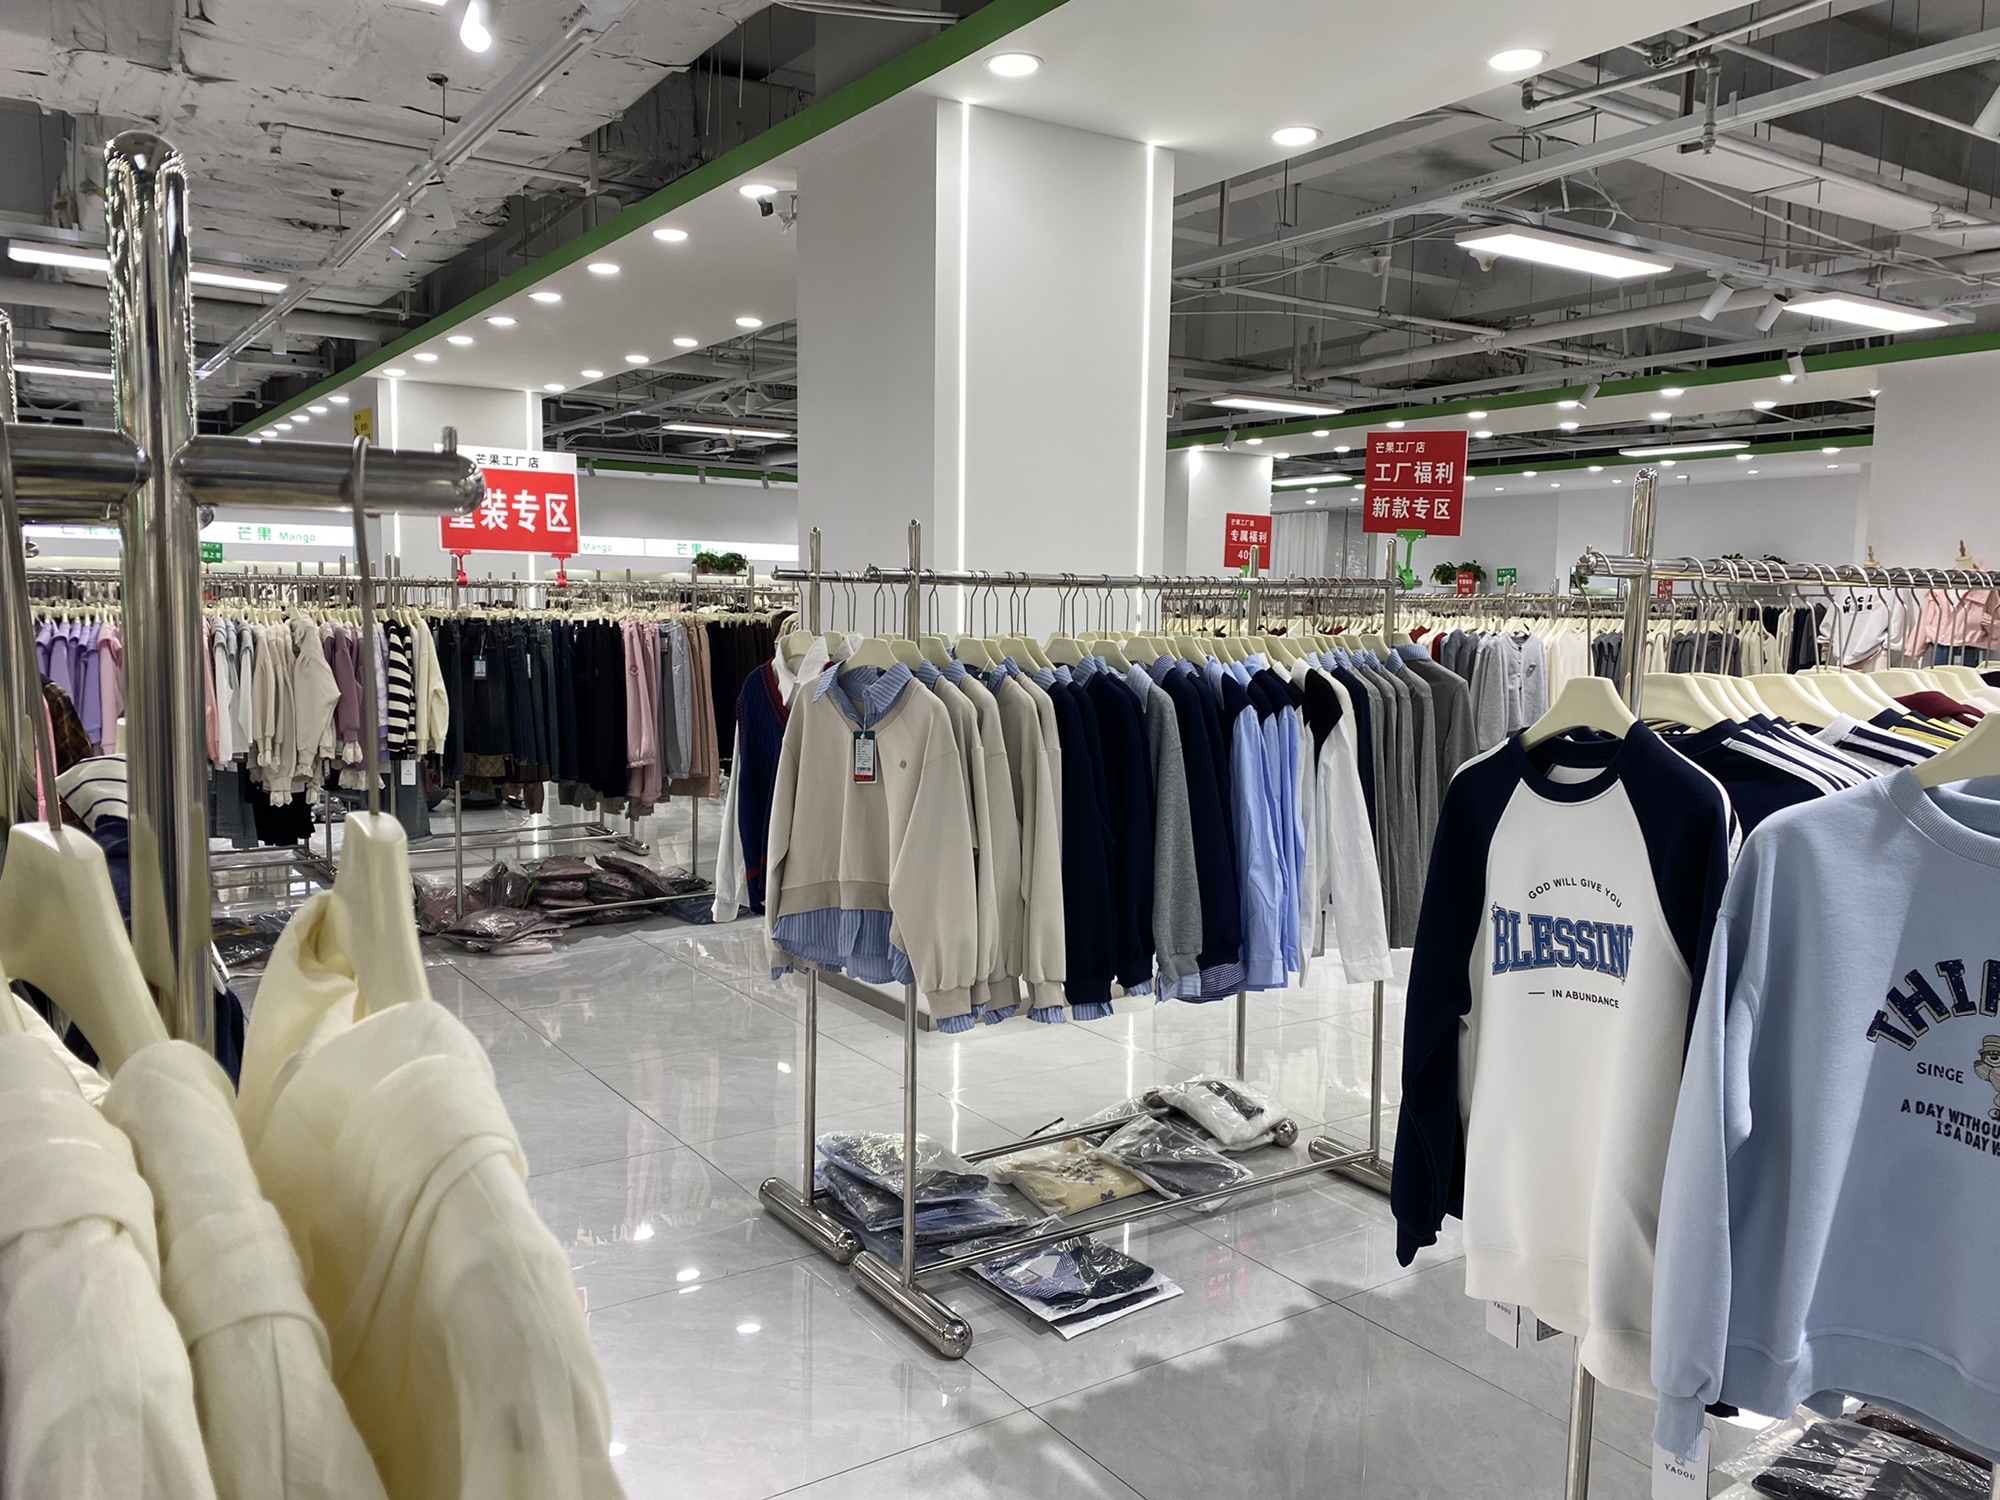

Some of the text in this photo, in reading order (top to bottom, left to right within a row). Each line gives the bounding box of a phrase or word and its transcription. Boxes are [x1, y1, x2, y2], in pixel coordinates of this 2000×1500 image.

[1375, 441, 1426, 453] 芒果工厂店
[475, 453, 540, 469] 芒果工厂店
[1373, 461, 1454, 484] 工厂福利
[1371, 496, 1451, 520] 新款专区
[237, 526, 316, 543] 芒果 Mango
[1230, 529, 1268, 543] 专属福利
[583, 542, 613, 552] Mango
[1528, 877, 1623, 908] GOD WILL GIVE YOU
[1552, 989, 1619, 1009] IN ABUNDANCE
[1916, 1062, 1964, 1084] SINGE
[1900, 1099, 1911, 1113] A
[1915, 1100, 1945, 1119] DAY
[1965, 1131, 1989, 1152] DAY
[1664, 1463, 1696, 1480] YAOOU
